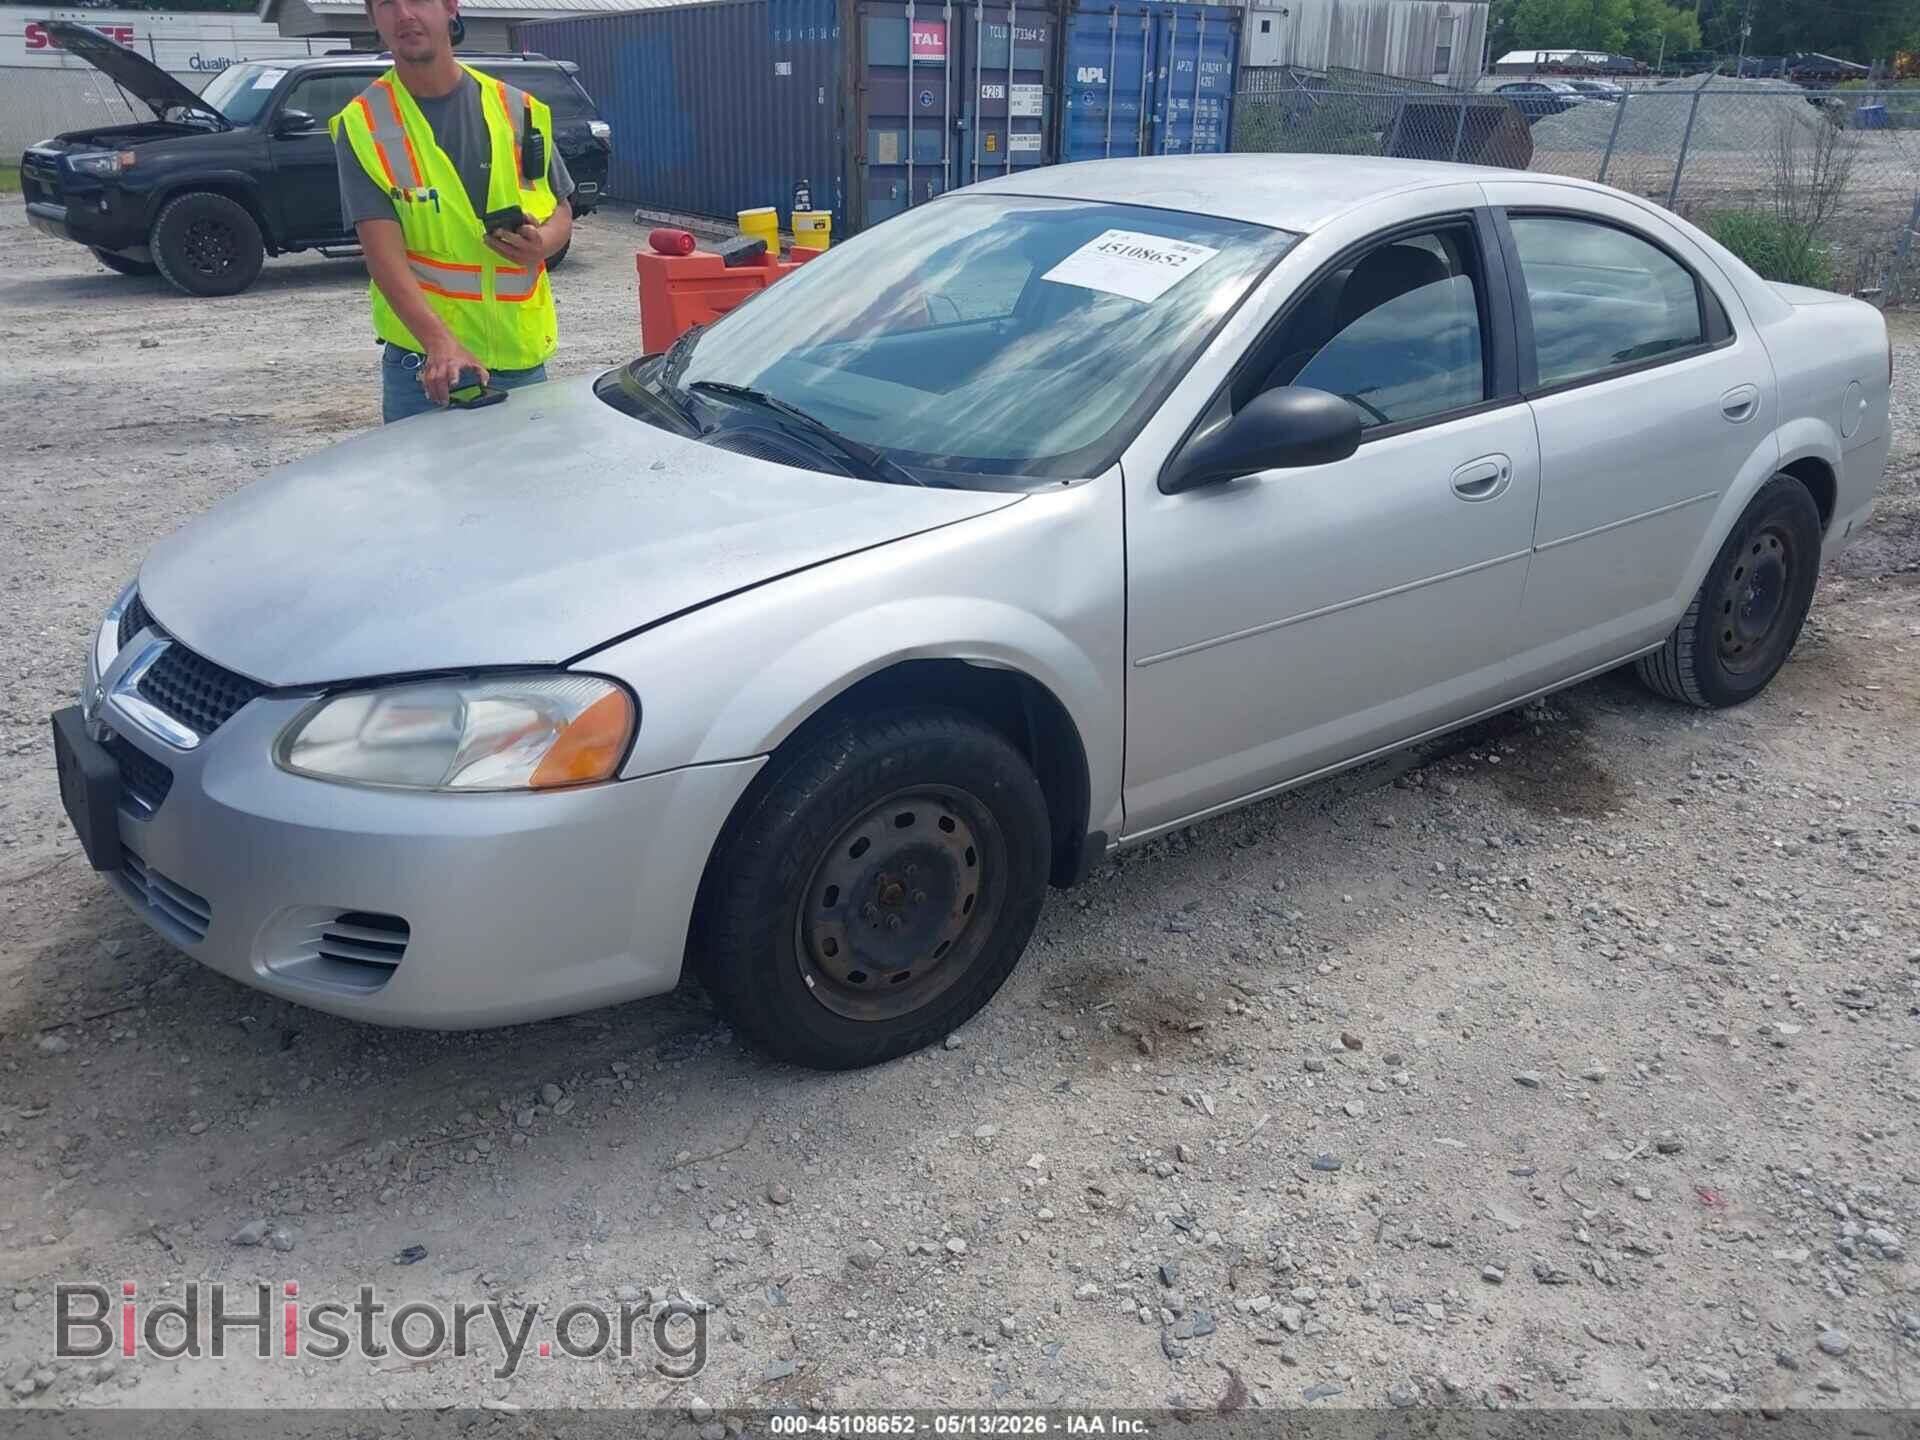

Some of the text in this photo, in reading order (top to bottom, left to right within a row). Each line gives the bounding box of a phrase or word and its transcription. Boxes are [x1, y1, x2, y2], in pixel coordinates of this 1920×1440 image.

[912, 33, 943, 46] TAL
[1076, 67, 1107, 84] APL
[1097, 241, 1188, 267] 45108652
